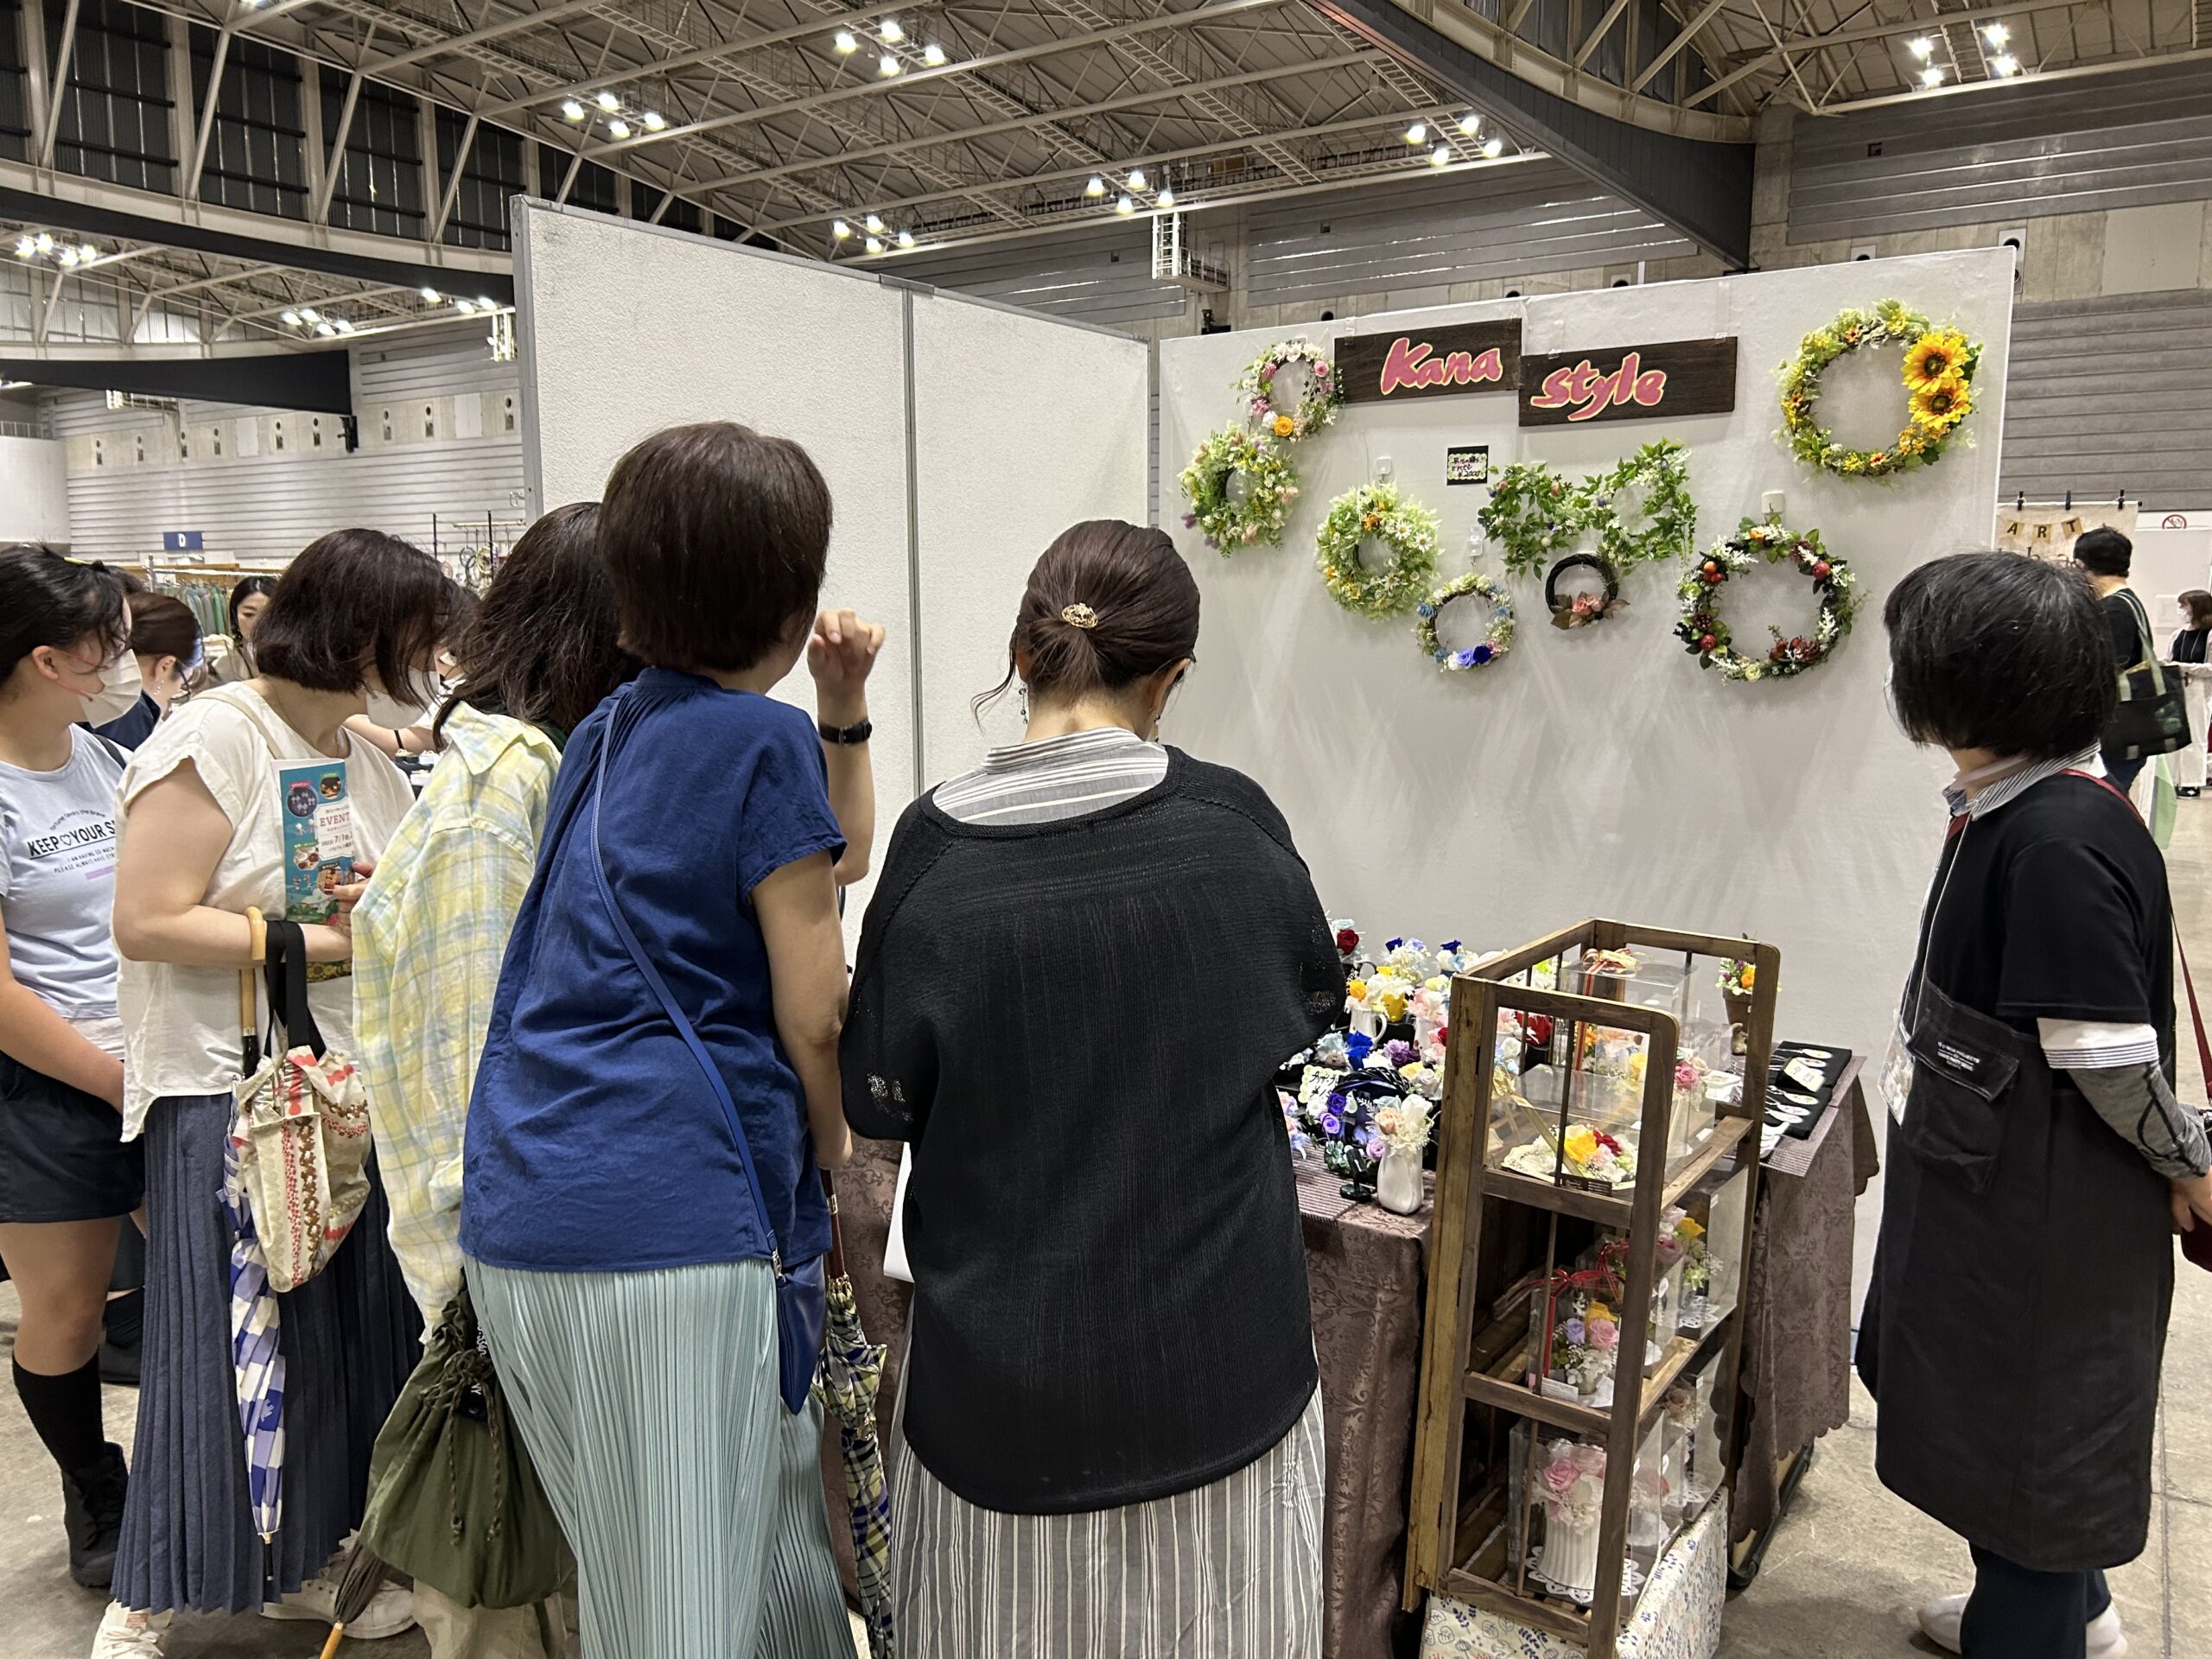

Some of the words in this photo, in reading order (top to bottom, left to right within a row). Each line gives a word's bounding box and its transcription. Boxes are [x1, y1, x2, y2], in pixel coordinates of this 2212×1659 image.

[1381, 337, 1503, 396] Kana
[178, 533, 186, 548] D
[320, 811, 350, 827] EVENT
[27, 836, 60, 857] KEEP
[69, 824, 107, 844] YOUR
[104, 819, 116, 835] S
